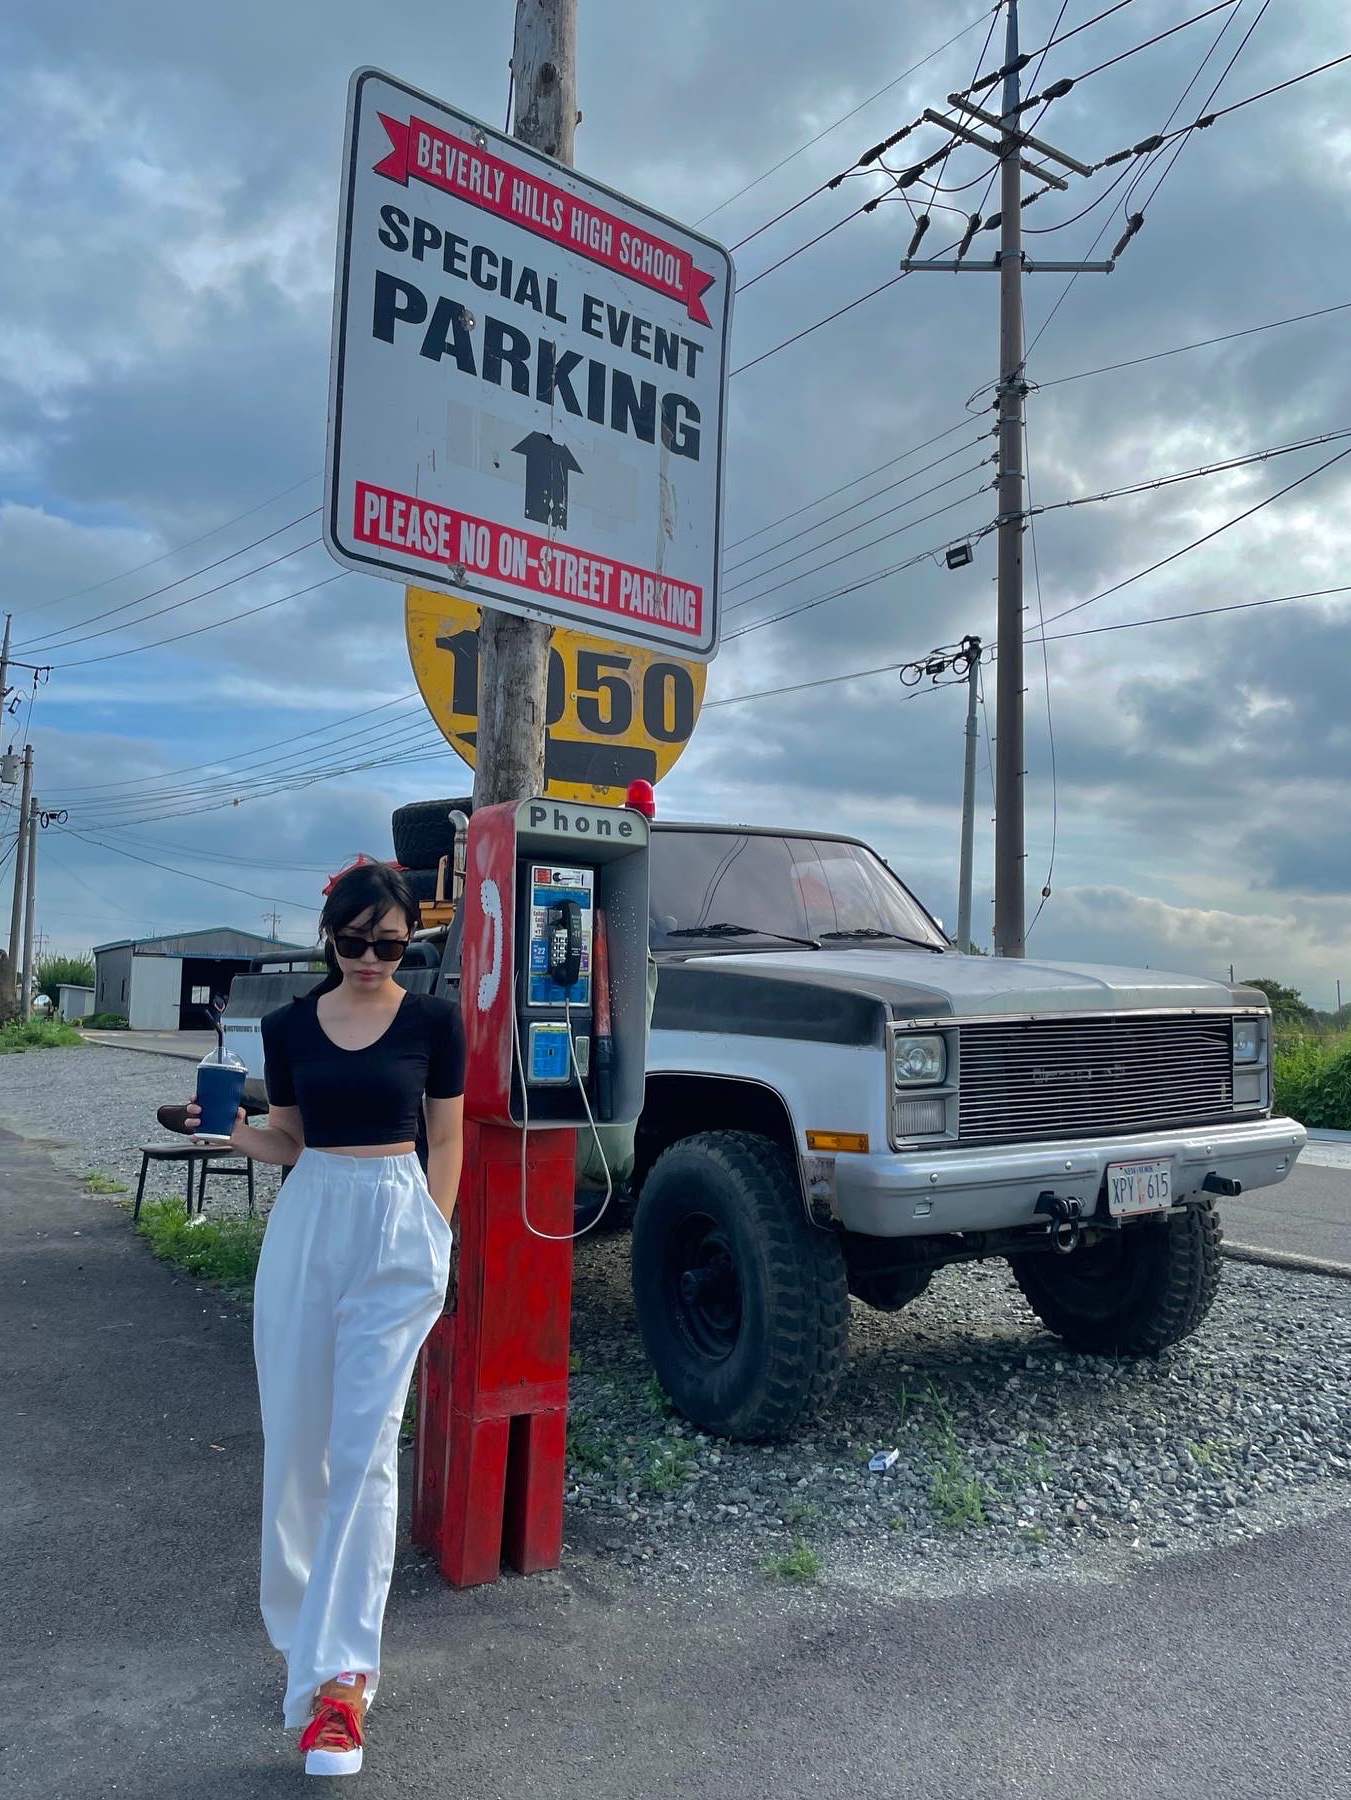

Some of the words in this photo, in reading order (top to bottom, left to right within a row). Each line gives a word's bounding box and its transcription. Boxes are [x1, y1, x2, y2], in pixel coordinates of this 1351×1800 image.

[417, 131, 505, 204] BEVERLY
[511, 178, 565, 232] HILLS
[570, 208, 613, 256] HIGH
[619, 231, 684, 291] SCHOOL
[372, 269, 701, 462] PARKING
[377, 204, 567, 324] SPECIAL
[581, 293, 704, 379] EVENT
[363, 491, 451, 559] PLEASE
[459, 519, 491, 570] NO
[499, 532, 614, 605] ON-STREET
[619, 566, 697, 630] PARKING
[530, 806, 633, 838] Phone
[1112, 1175, 1134, 1205] XPY
[1147, 1172, 1168, 1199] 615
